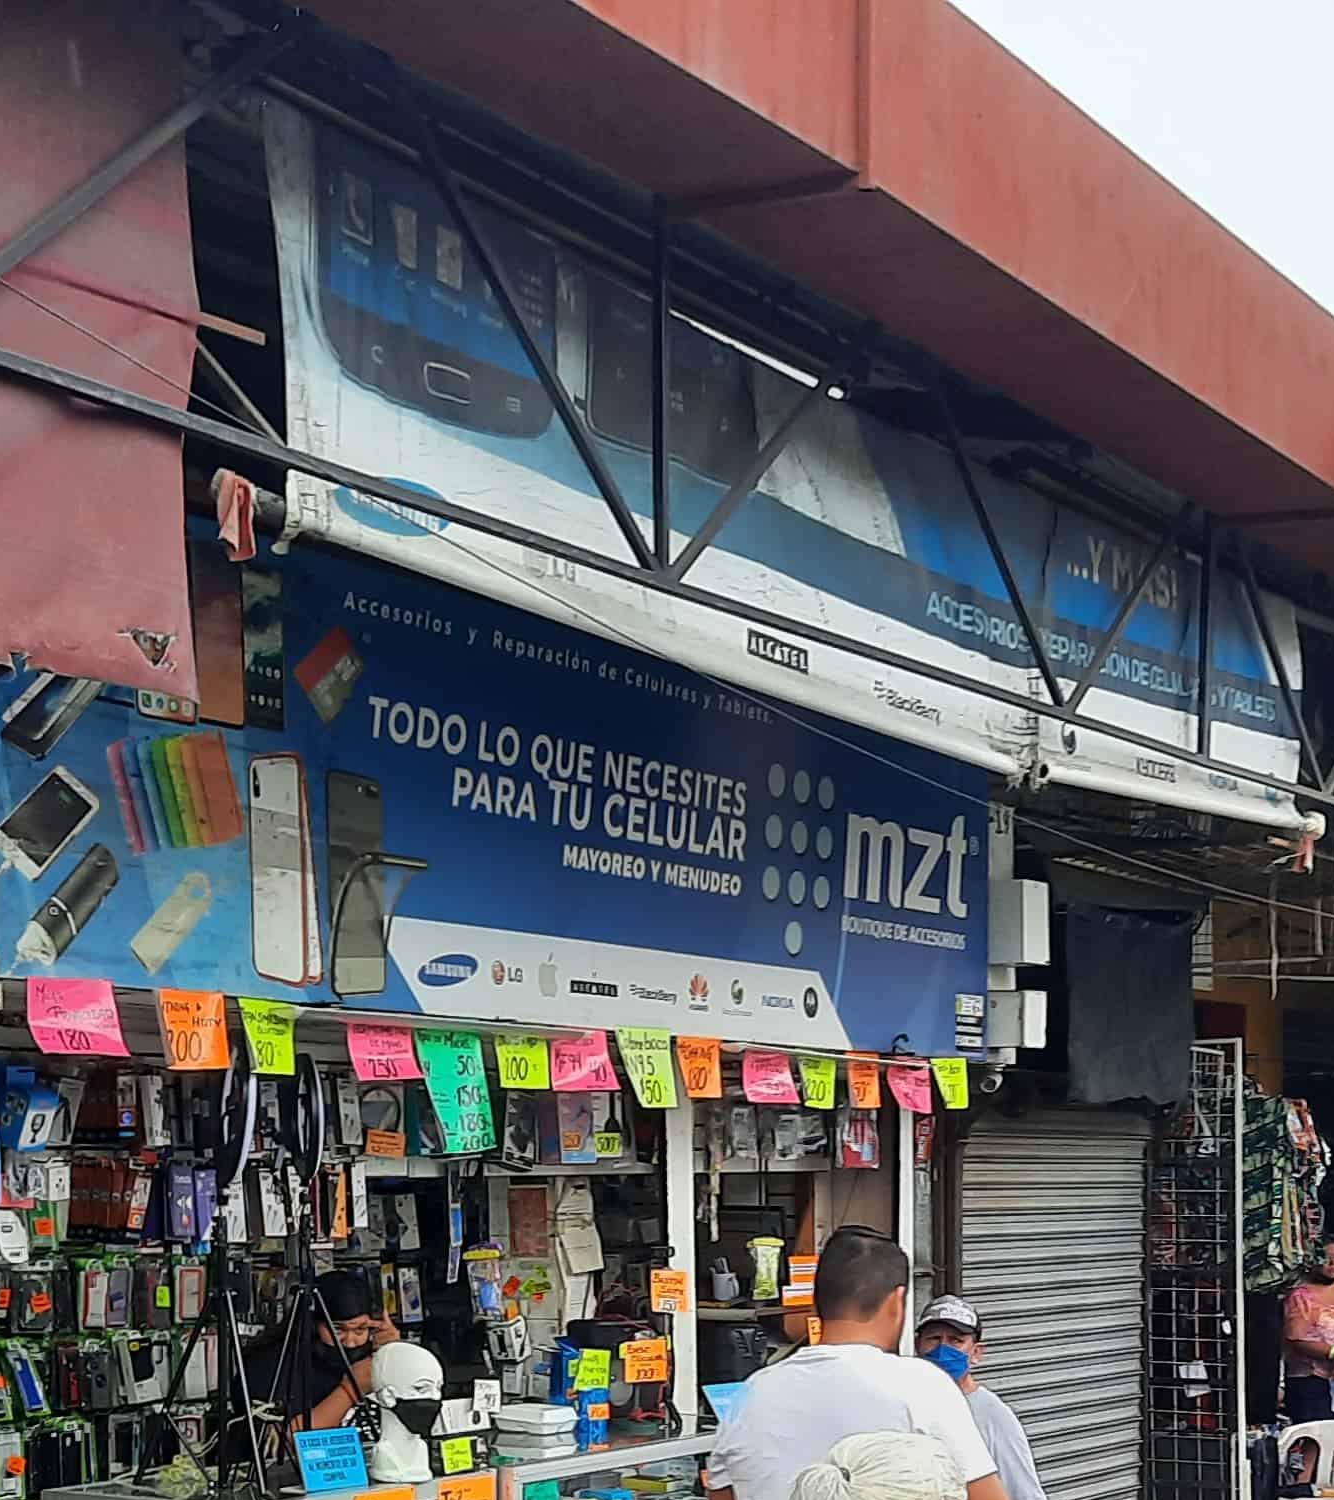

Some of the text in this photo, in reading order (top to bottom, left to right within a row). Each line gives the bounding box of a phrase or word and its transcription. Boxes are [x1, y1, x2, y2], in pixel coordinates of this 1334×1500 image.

[342, 591, 453, 636] Accesorios
[467, 627, 478, 646] y
[492, 629, 591, 675] Reparación
[598, 659, 619, 682] de
[624, 666, 698, 705] Celulares
[702, 694, 713, 711] y
[369, 696, 747, 818] TODO LO QUE NECESITES
[451, 767, 747, 862] PARA TU CELULAR
[563, 844, 741, 897] MAYOREO Y MENUDEO
[843, 812, 968, 919] mzt
[507, 967, 524, 983] LG
